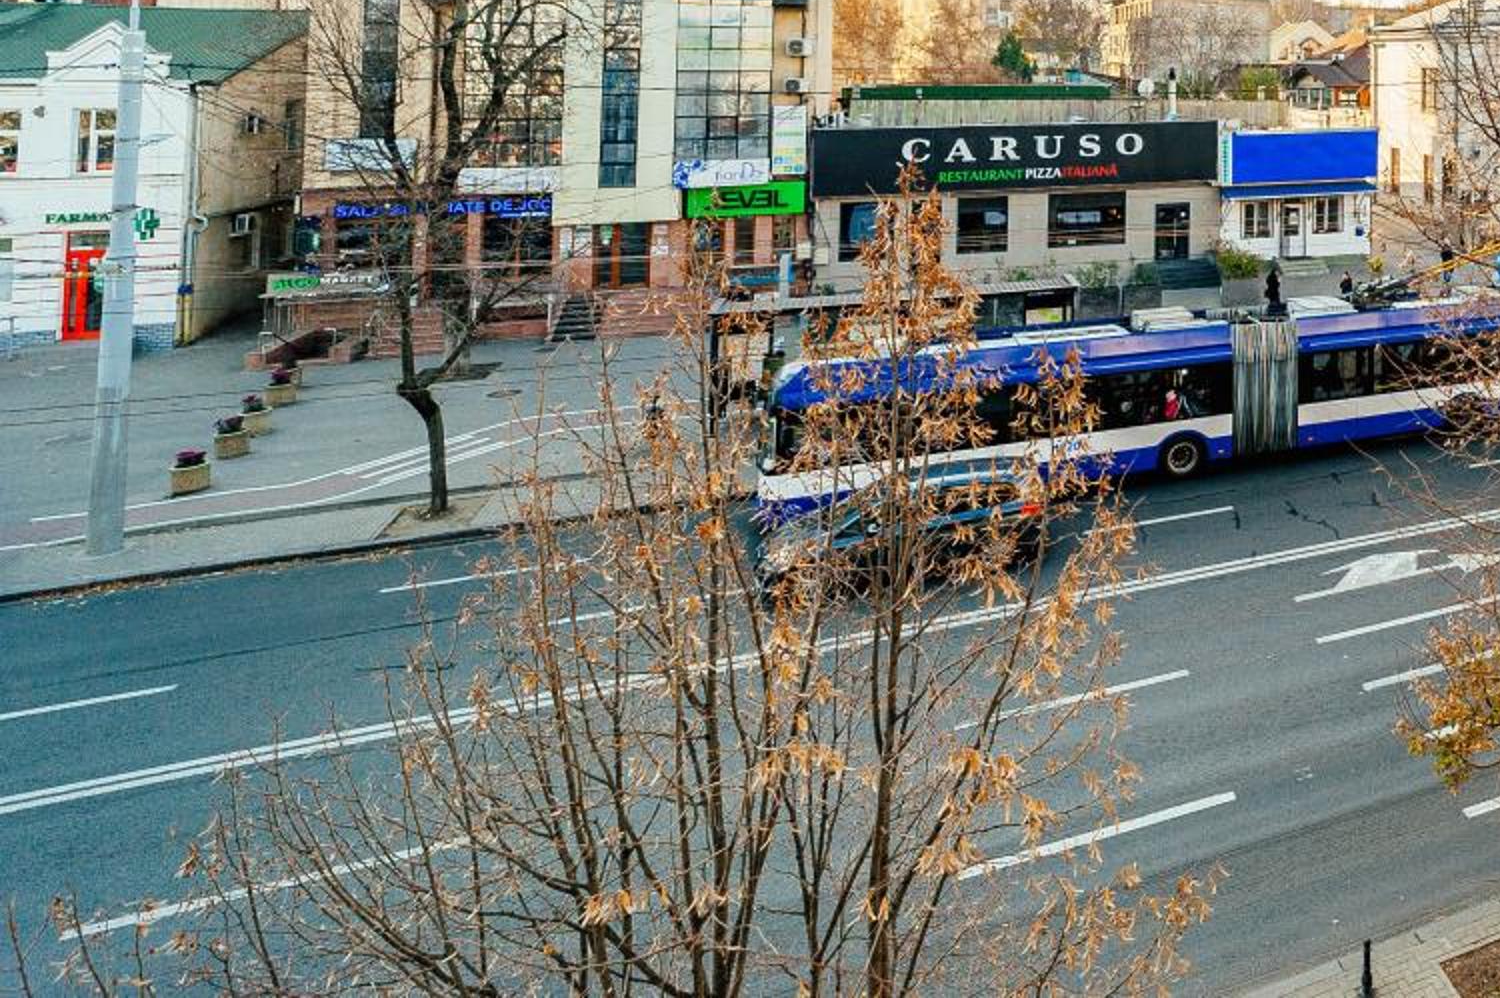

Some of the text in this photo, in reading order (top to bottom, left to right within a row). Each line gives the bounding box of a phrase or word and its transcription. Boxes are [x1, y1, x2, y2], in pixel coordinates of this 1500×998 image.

[901, 133, 1145, 163] CARUSO
[938, 168, 1024, 183] RESTAURANT
[1025, 166, 1062, 180] PIZZA
[703, 188, 789, 210] EVEL
[45, 212, 111, 224] FARMA
